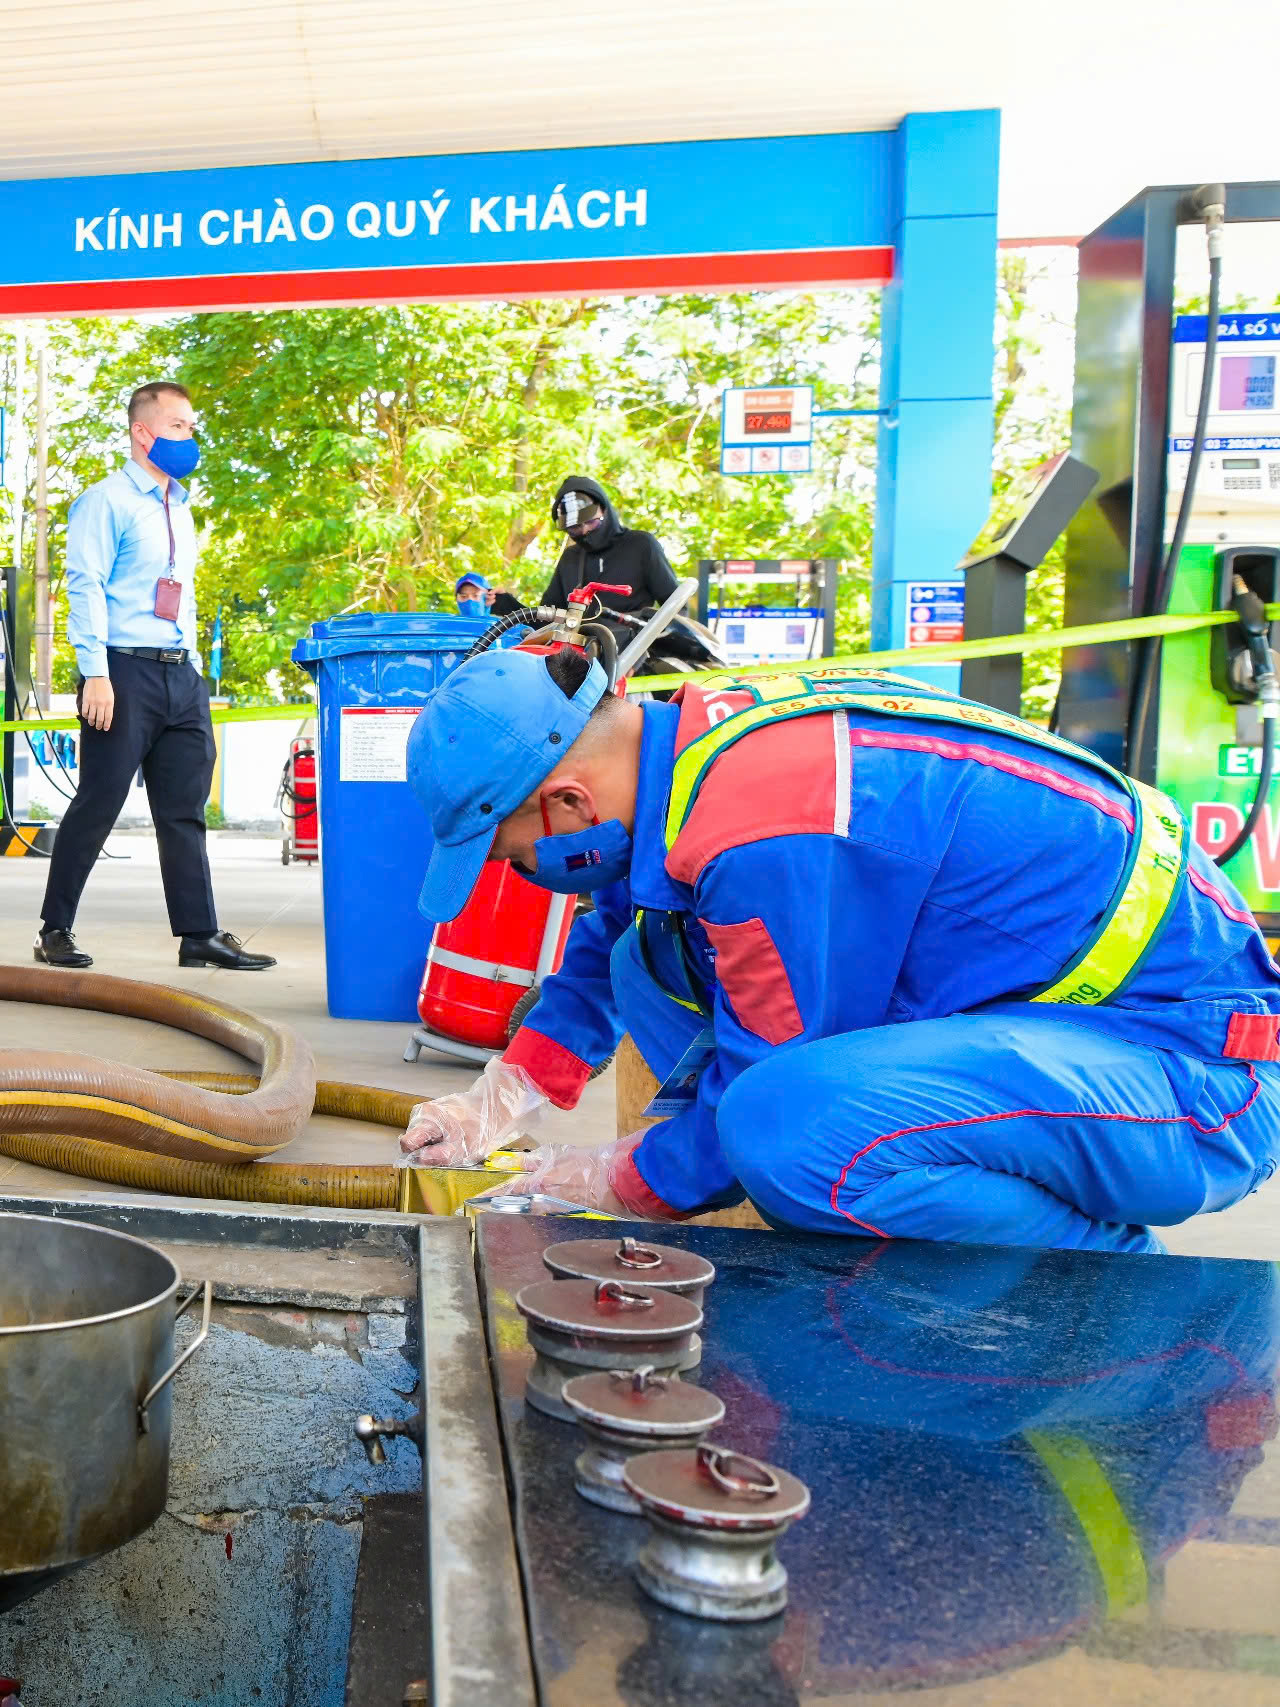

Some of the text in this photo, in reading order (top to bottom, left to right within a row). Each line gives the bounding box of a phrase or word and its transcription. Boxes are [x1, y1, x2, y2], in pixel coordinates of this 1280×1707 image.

[74, 183, 648, 252] KÍNH CHÀO QUÝ KHÁCH
[1217, 319, 1240, 336] RẢ
[1243, 318, 1269, 336] SỐ
[882, 700, 916, 711] 92
